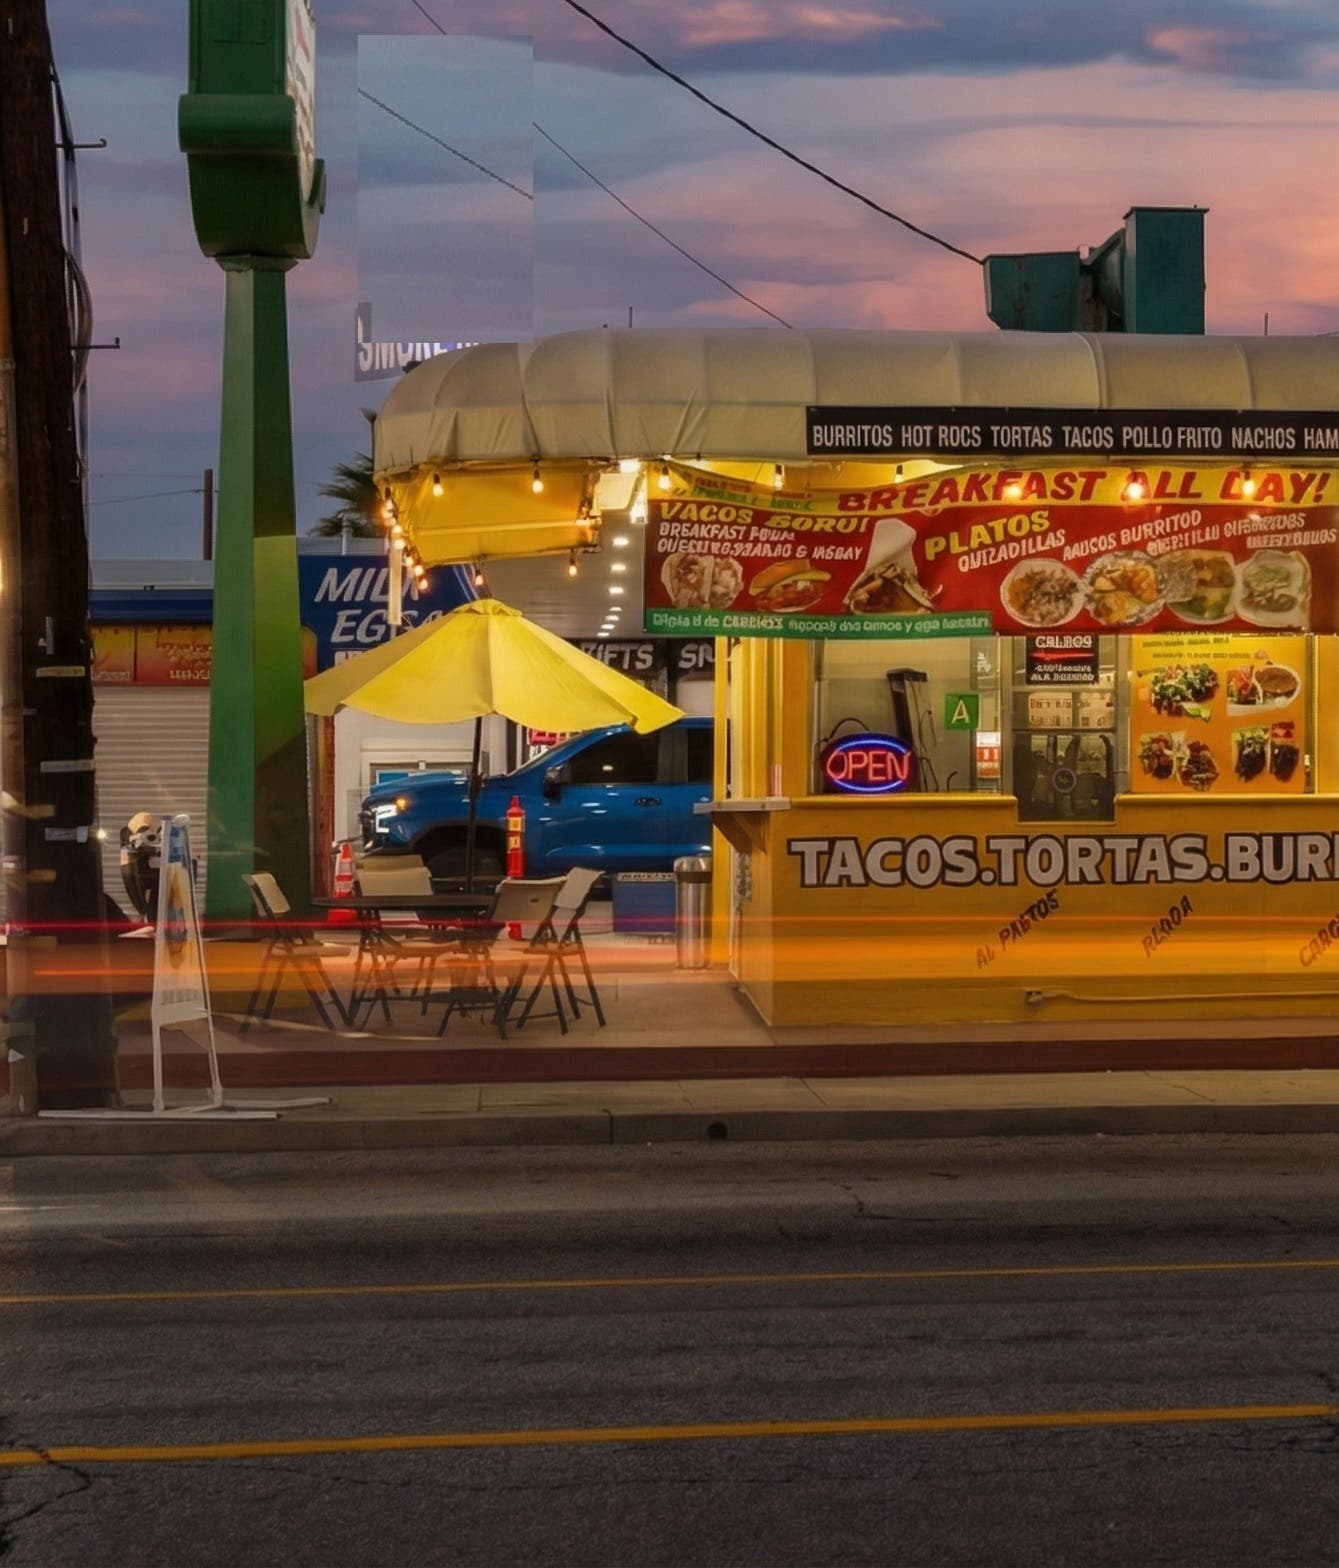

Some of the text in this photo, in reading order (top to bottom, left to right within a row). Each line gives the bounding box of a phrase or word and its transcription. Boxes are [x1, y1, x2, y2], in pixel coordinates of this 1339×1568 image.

[813, 425, 892, 448] BURRITOS
[902, 425, 932, 448] HOT
[991, 425, 1052, 448] TORTAS
[1062, 426, 1114, 449] TACOS
[1122, 426, 1172, 449] POLLO
[1178, 426, 1222, 449] FRITO
[1232, 427, 1296, 450] NACHOS
[838, 471, 1107, 512] BREAKFAST
[925, 510, 1051, 560] PLATOS
[951, 699, 970, 724] A
[826, 750, 910, 783] OPEN
